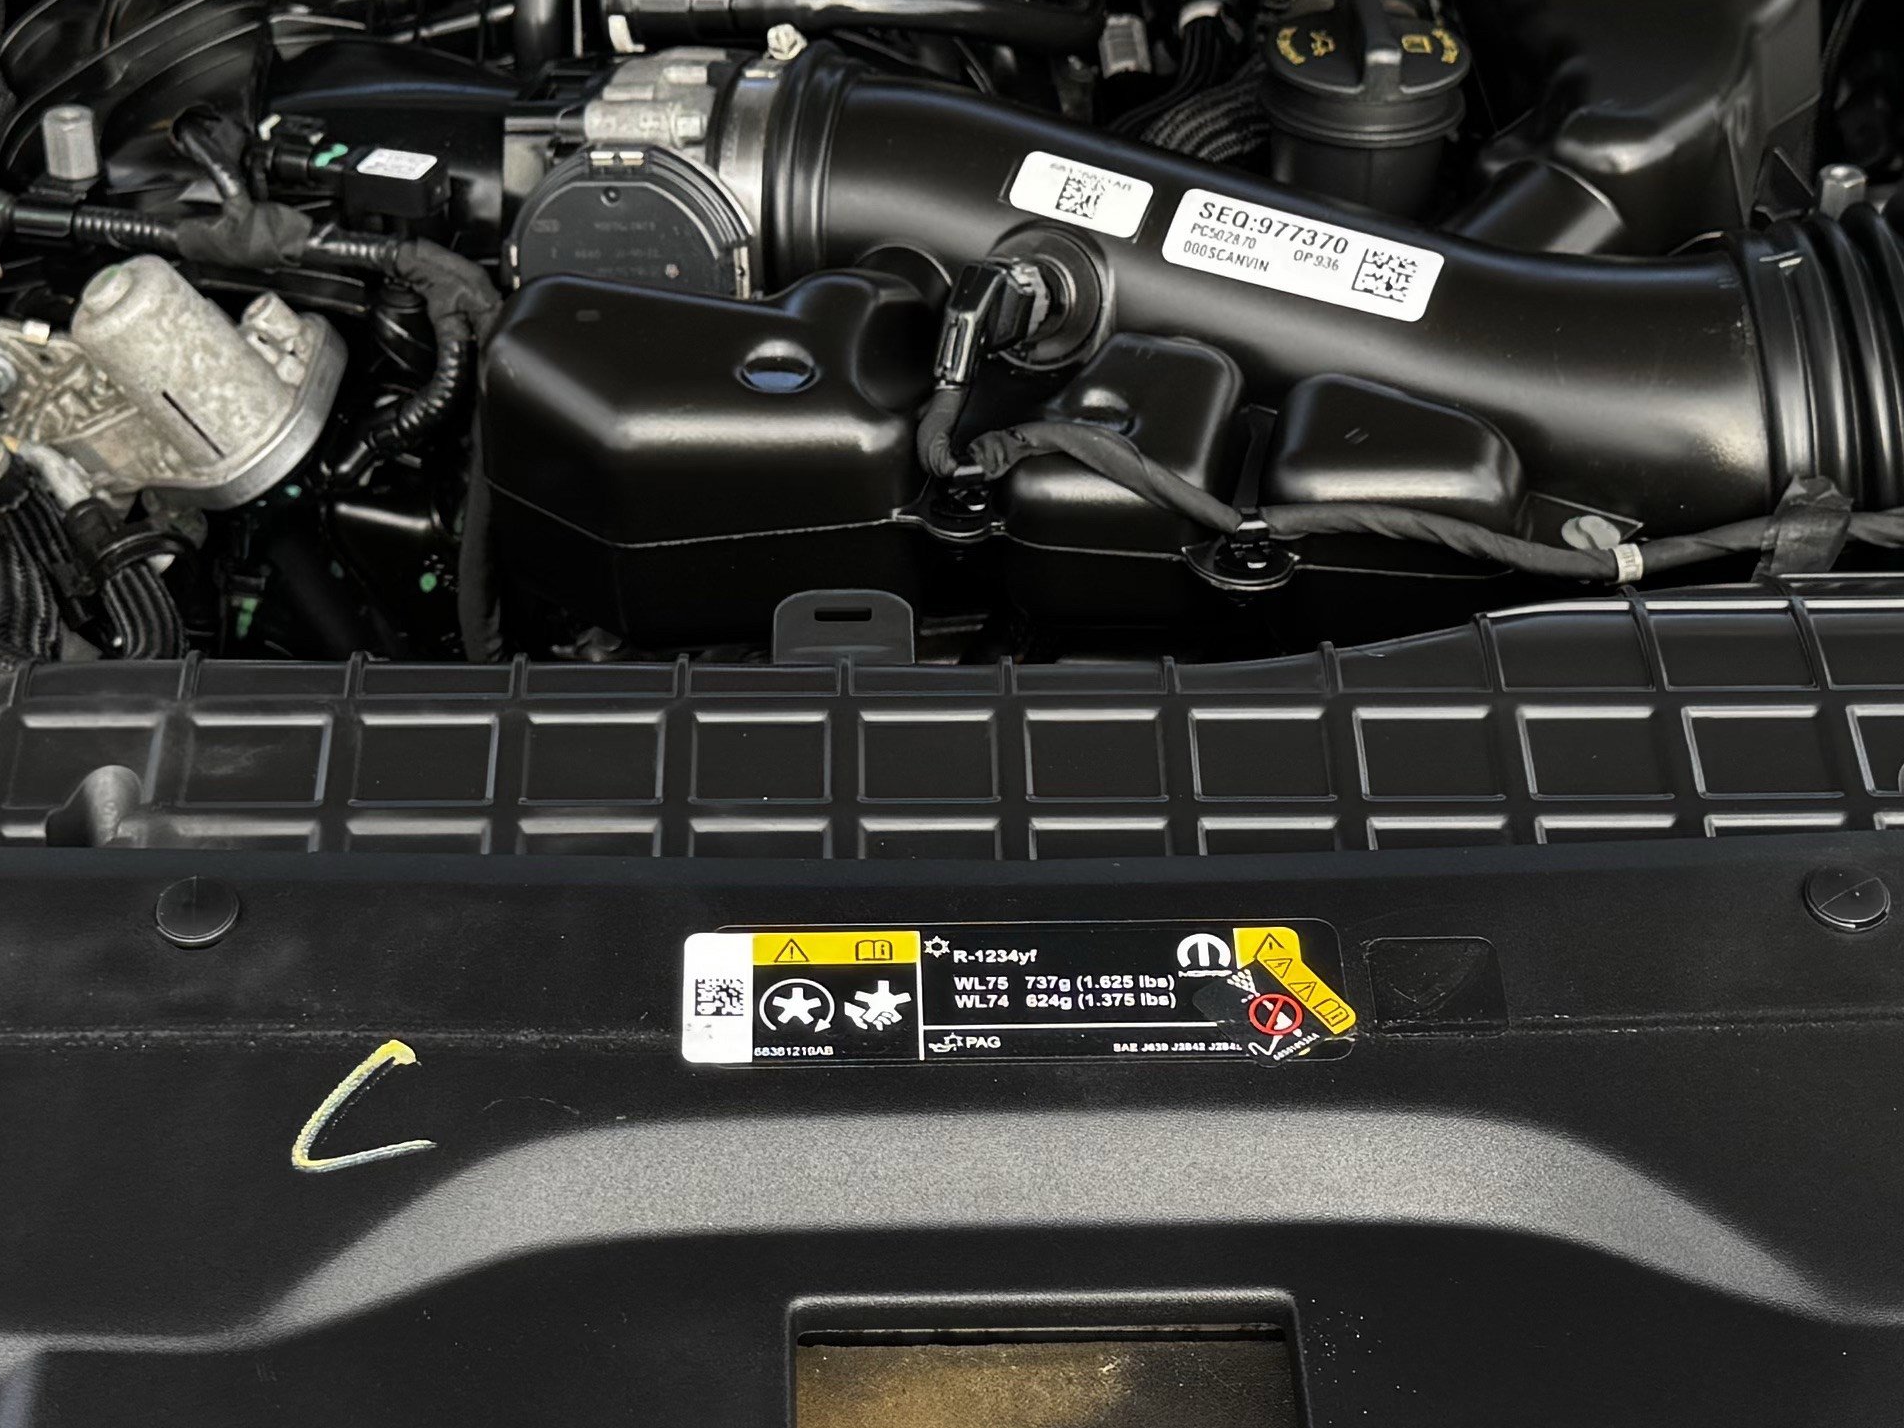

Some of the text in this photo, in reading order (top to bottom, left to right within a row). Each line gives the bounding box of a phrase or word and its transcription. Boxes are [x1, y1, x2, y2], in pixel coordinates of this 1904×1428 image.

[1198, 201, 1349, 254] SEQ:977370
[953, 948, 1038, 966] R-1234yf
[954, 974, 1176, 992] WL75 737g (1.625 lbs)
[955, 992, 1177, 1010] WL74 624g (1.375 lbs)
[966, 1036, 1001, 1049] PAG
